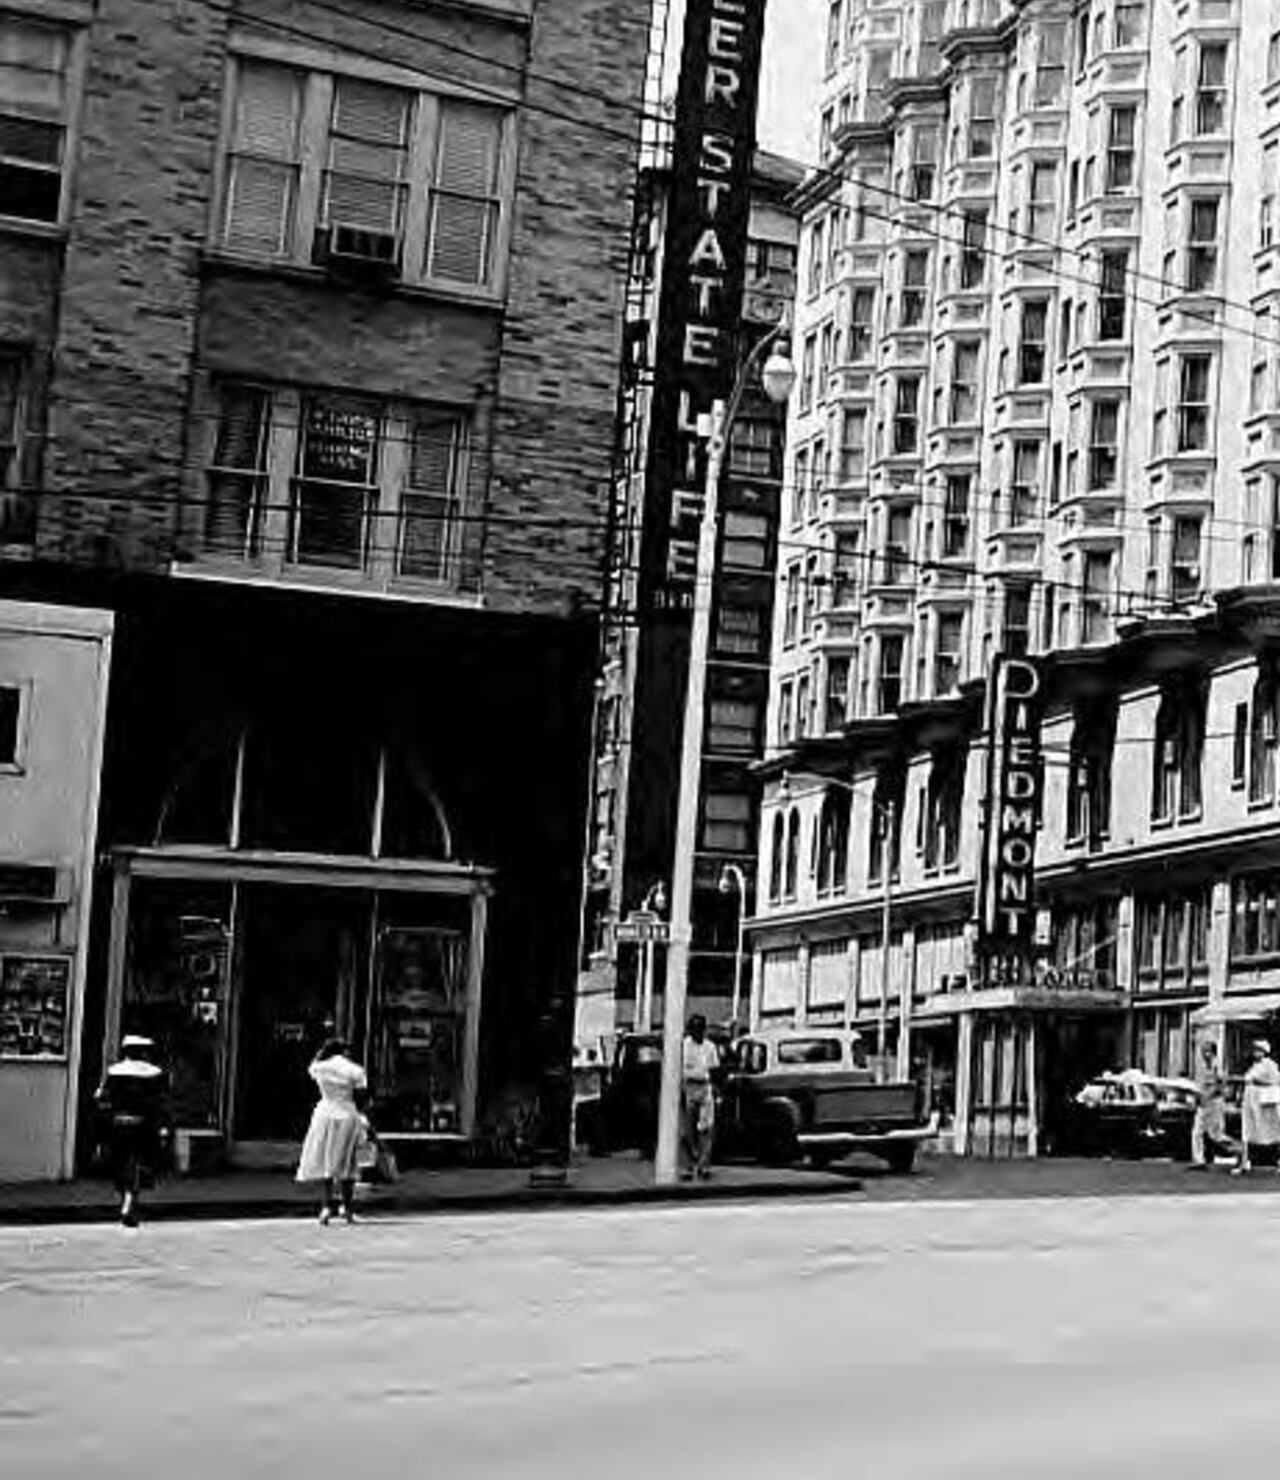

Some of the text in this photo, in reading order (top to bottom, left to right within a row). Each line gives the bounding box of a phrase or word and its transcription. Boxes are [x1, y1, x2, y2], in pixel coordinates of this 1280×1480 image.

[683, 134, 735, 366] STATE
[667, 389, 706, 581] LIFE
[985, 659, 1040, 935] PIEDMONT
